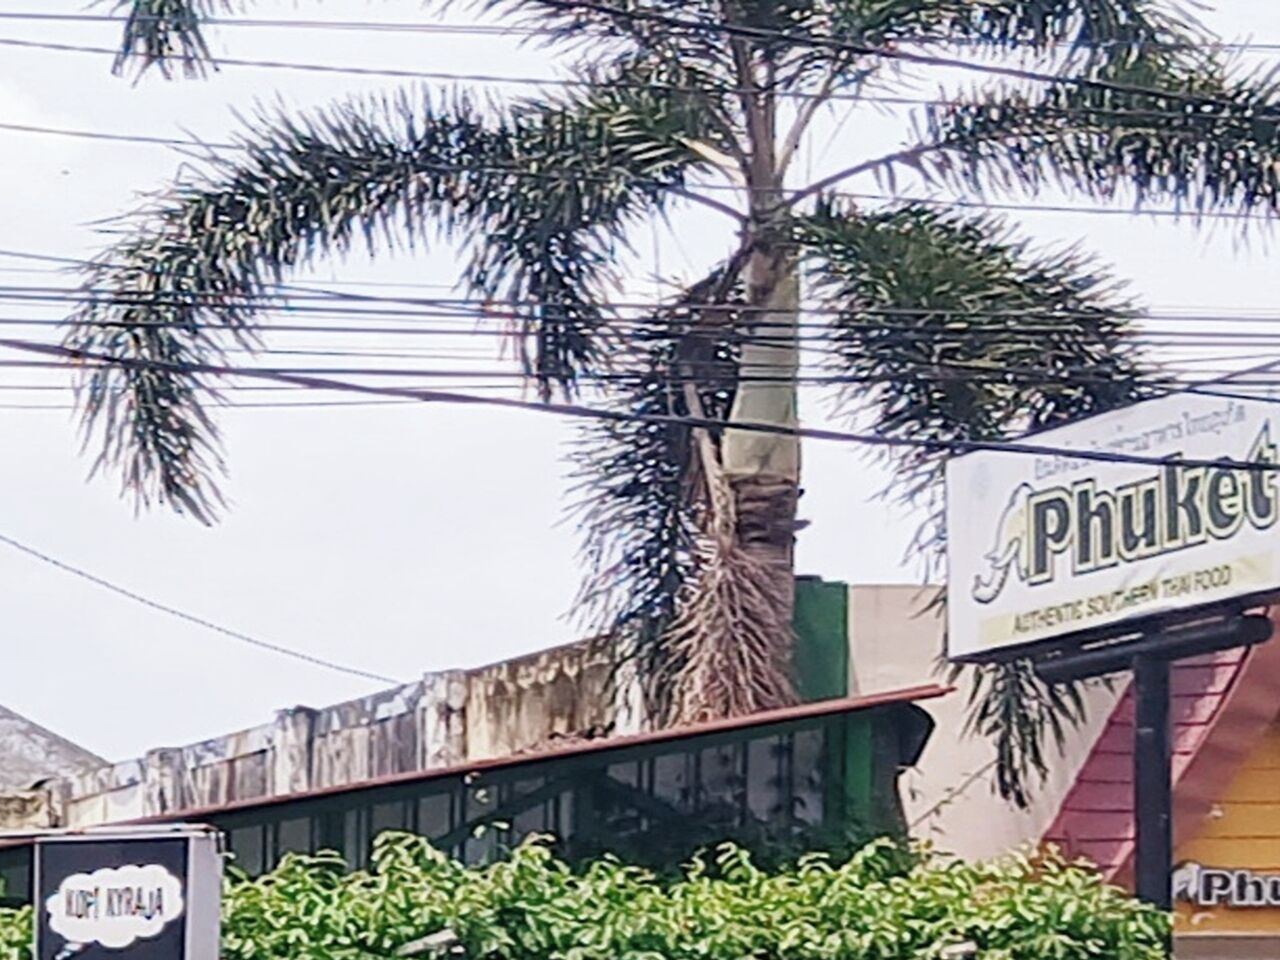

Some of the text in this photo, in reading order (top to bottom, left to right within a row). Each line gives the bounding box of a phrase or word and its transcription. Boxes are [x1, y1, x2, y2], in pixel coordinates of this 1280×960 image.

[1027, 420, 1280, 586] Phuket
[1012, 599, 1083, 635] AUTHENTIC
[1087, 582, 1159, 617] SOUTHERN
[1193, 564, 1232, 591] FOOD
